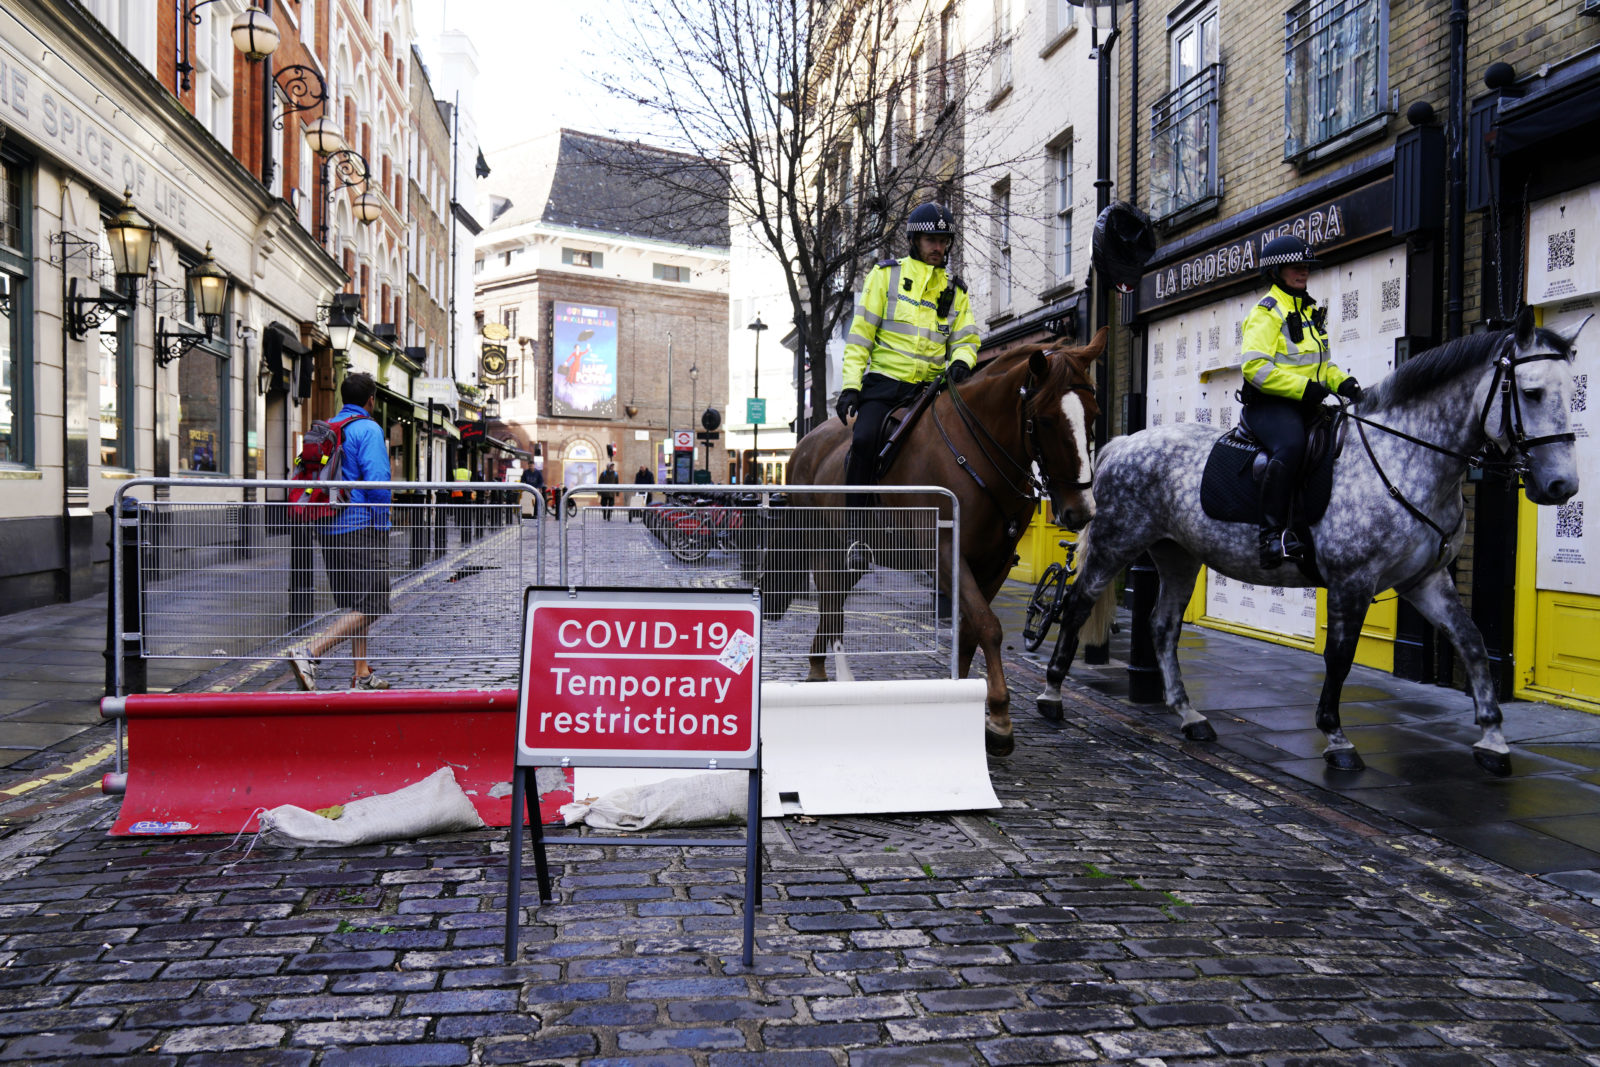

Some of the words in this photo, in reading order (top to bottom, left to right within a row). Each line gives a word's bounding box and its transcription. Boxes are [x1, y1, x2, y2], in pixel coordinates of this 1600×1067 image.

[41, 93, 113, 179] SPICE
[122, 153, 146, 197] OF
[154, 175, 187, 229] LIFE
[1155, 268, 1177, 299] LA
[1181, 240, 1254, 290] BODEGA
[557, 619, 729, 649] COVID-19
[550, 667, 732, 703] Temporary
[539, 706, 739, 736] restrictions
